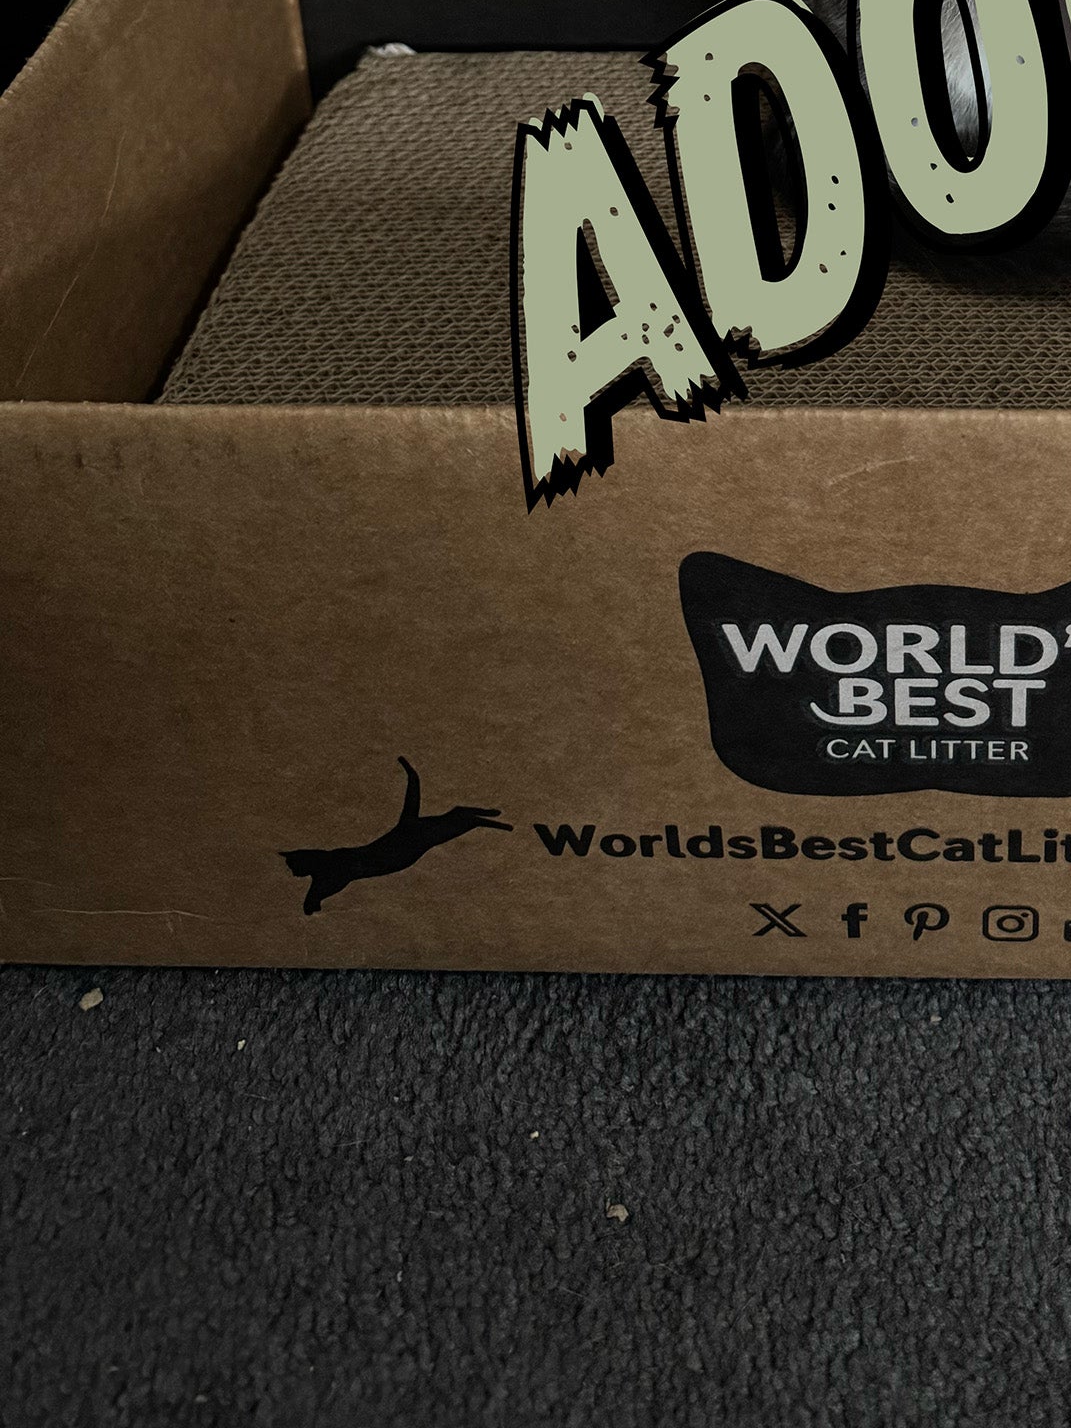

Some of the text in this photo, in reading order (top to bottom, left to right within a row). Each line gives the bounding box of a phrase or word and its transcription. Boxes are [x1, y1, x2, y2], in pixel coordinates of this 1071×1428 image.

[810, 677, 1047, 728] BEST
[826, 738, 1030, 761] CAT LITTER
